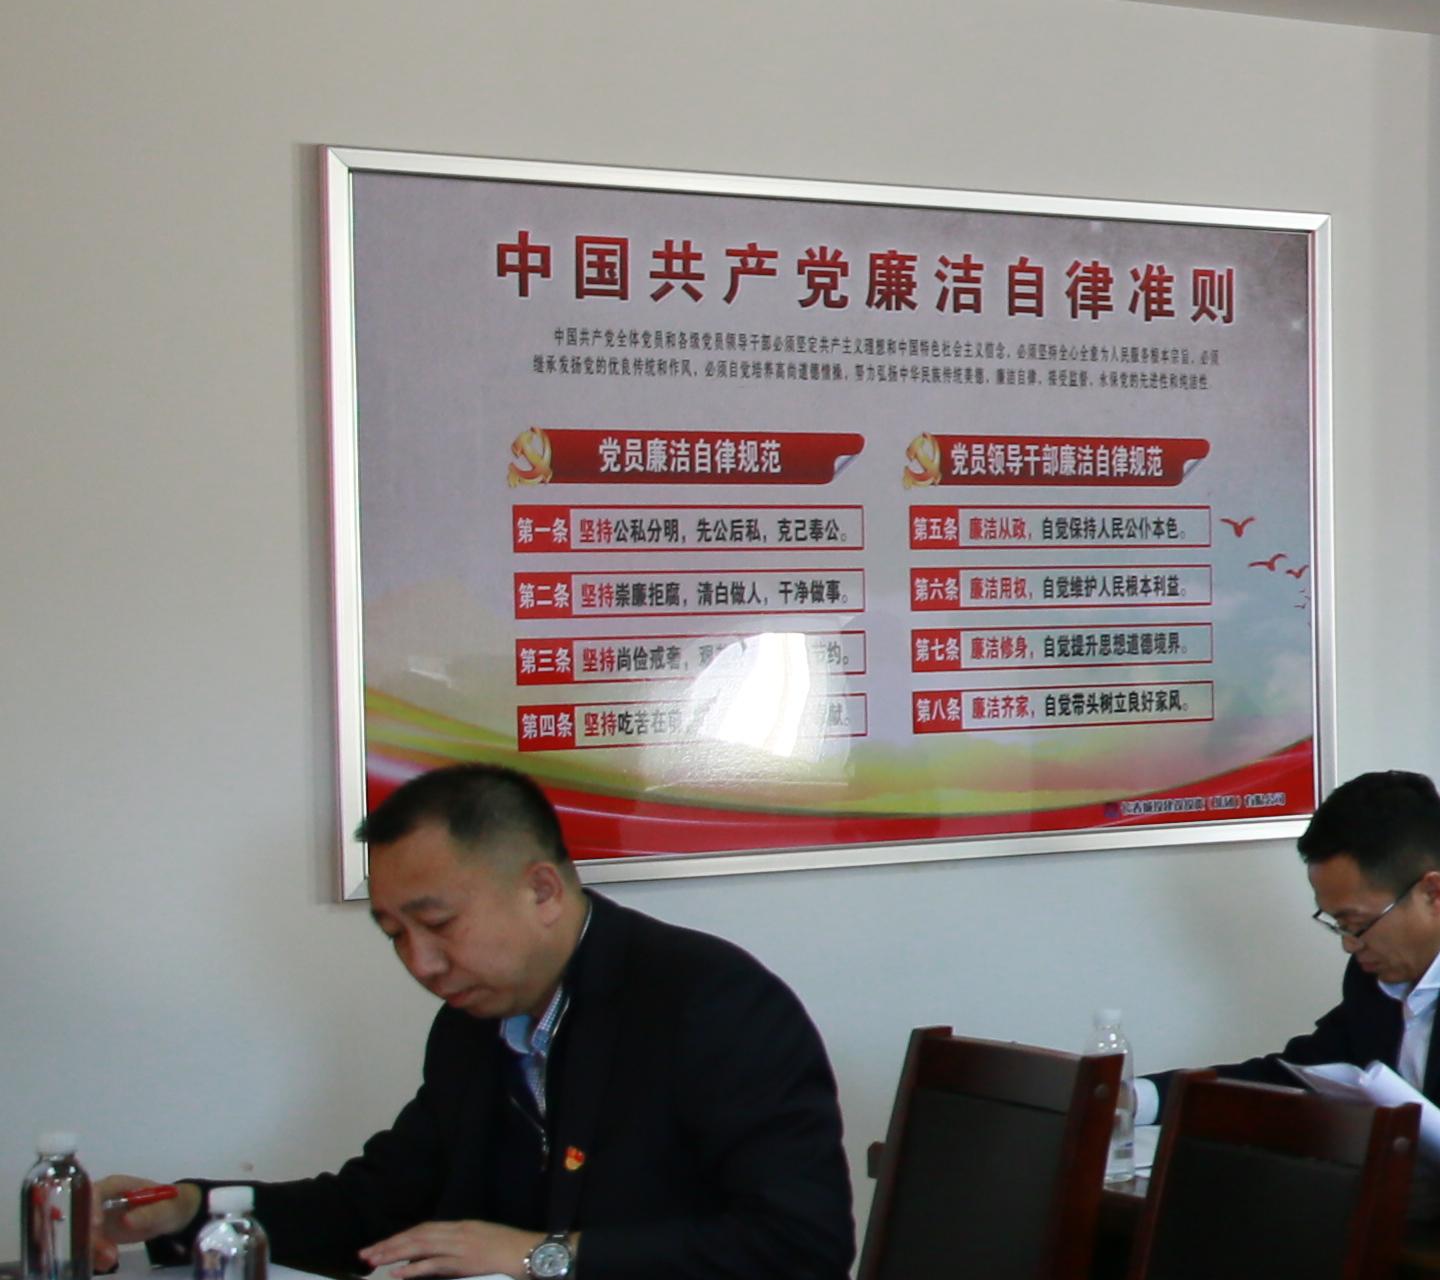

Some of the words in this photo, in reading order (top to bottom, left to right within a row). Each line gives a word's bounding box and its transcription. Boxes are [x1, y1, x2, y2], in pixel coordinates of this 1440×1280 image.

[496, 230, 1235, 325] 中国共产党廉洁自律准则
[598, 437, 782, 475] 党员廉洁自律规范
[950, 443, 1164, 478] 党员领导干部廉洁自律规范
[517, 517, 569, 542] 第一条
[579, 517, 848, 545] 坚持公私分明，先公后私，克己奉公。
[913, 516, 958, 542] 第五条
[969, 516, 1186, 542] 廉洁从政，自觉保持人民公仆本色。
[518, 581, 570, 609] 第二条
[581, 578, 849, 609] 坚持崇廉拒腐，清白做人，干净做事。
[914, 576, 960, 602] 第六条
[970, 575, 1187, 602] 廉洁用权，自觉维护人民根本利益。
[519, 646, 572, 673] 第三条
[915, 637, 960, 662] 第七条
[970, 634, 1188, 662] 廉洁修身，自觉提升思想道德境界。
[916, 697, 961, 723] 第八条
[971, 689, 1190, 718] 廉洁齐家，自觉带头树立良好家风。
[521, 711, 574, 739] 第四条
